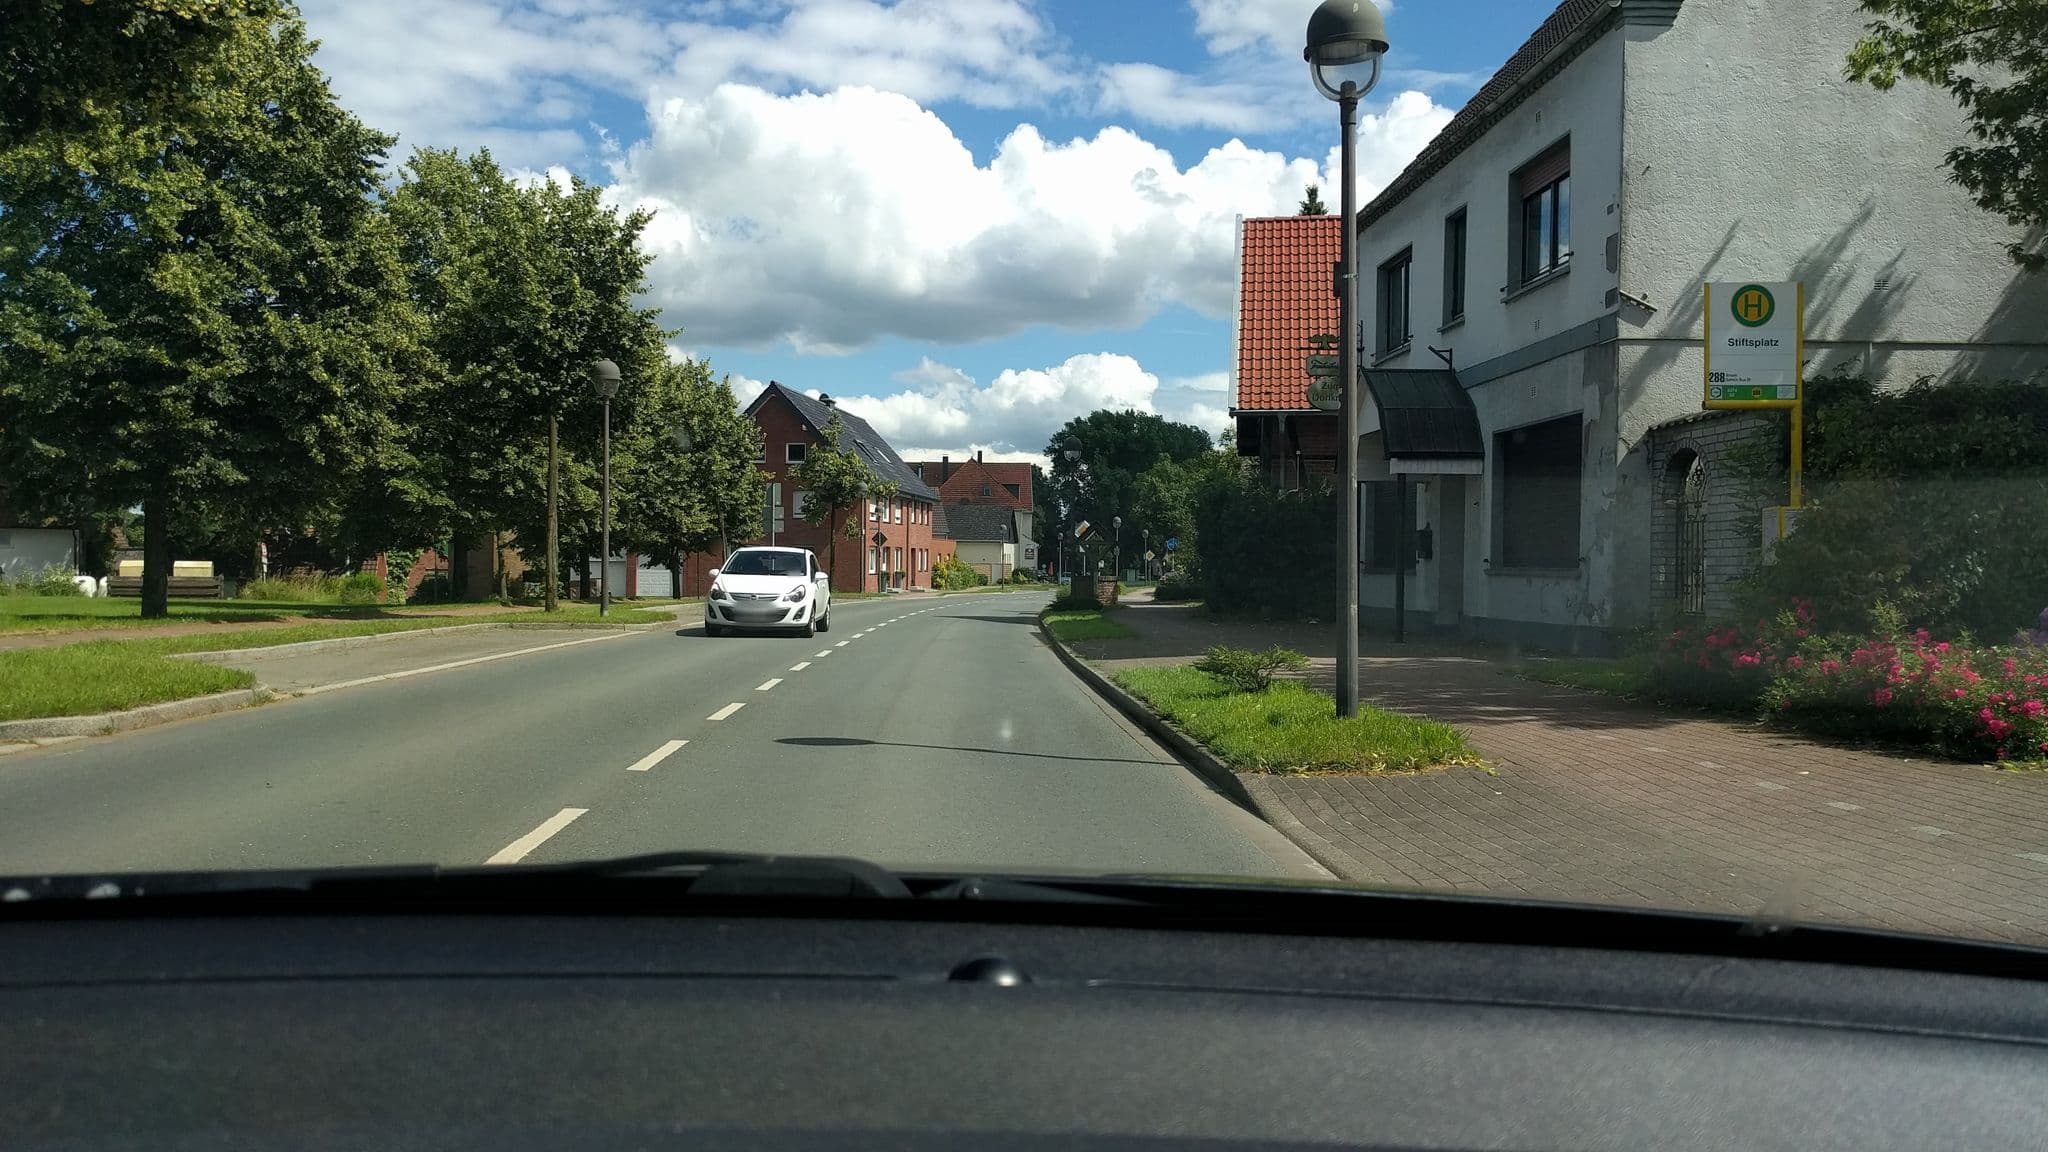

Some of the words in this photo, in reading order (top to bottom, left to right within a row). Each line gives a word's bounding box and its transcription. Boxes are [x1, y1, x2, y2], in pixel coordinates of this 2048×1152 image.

[1743, 294, 1762, 318] H
[1727, 337, 1779, 349] Stiftsplatz
[1708, 372, 1725, 383] 288
